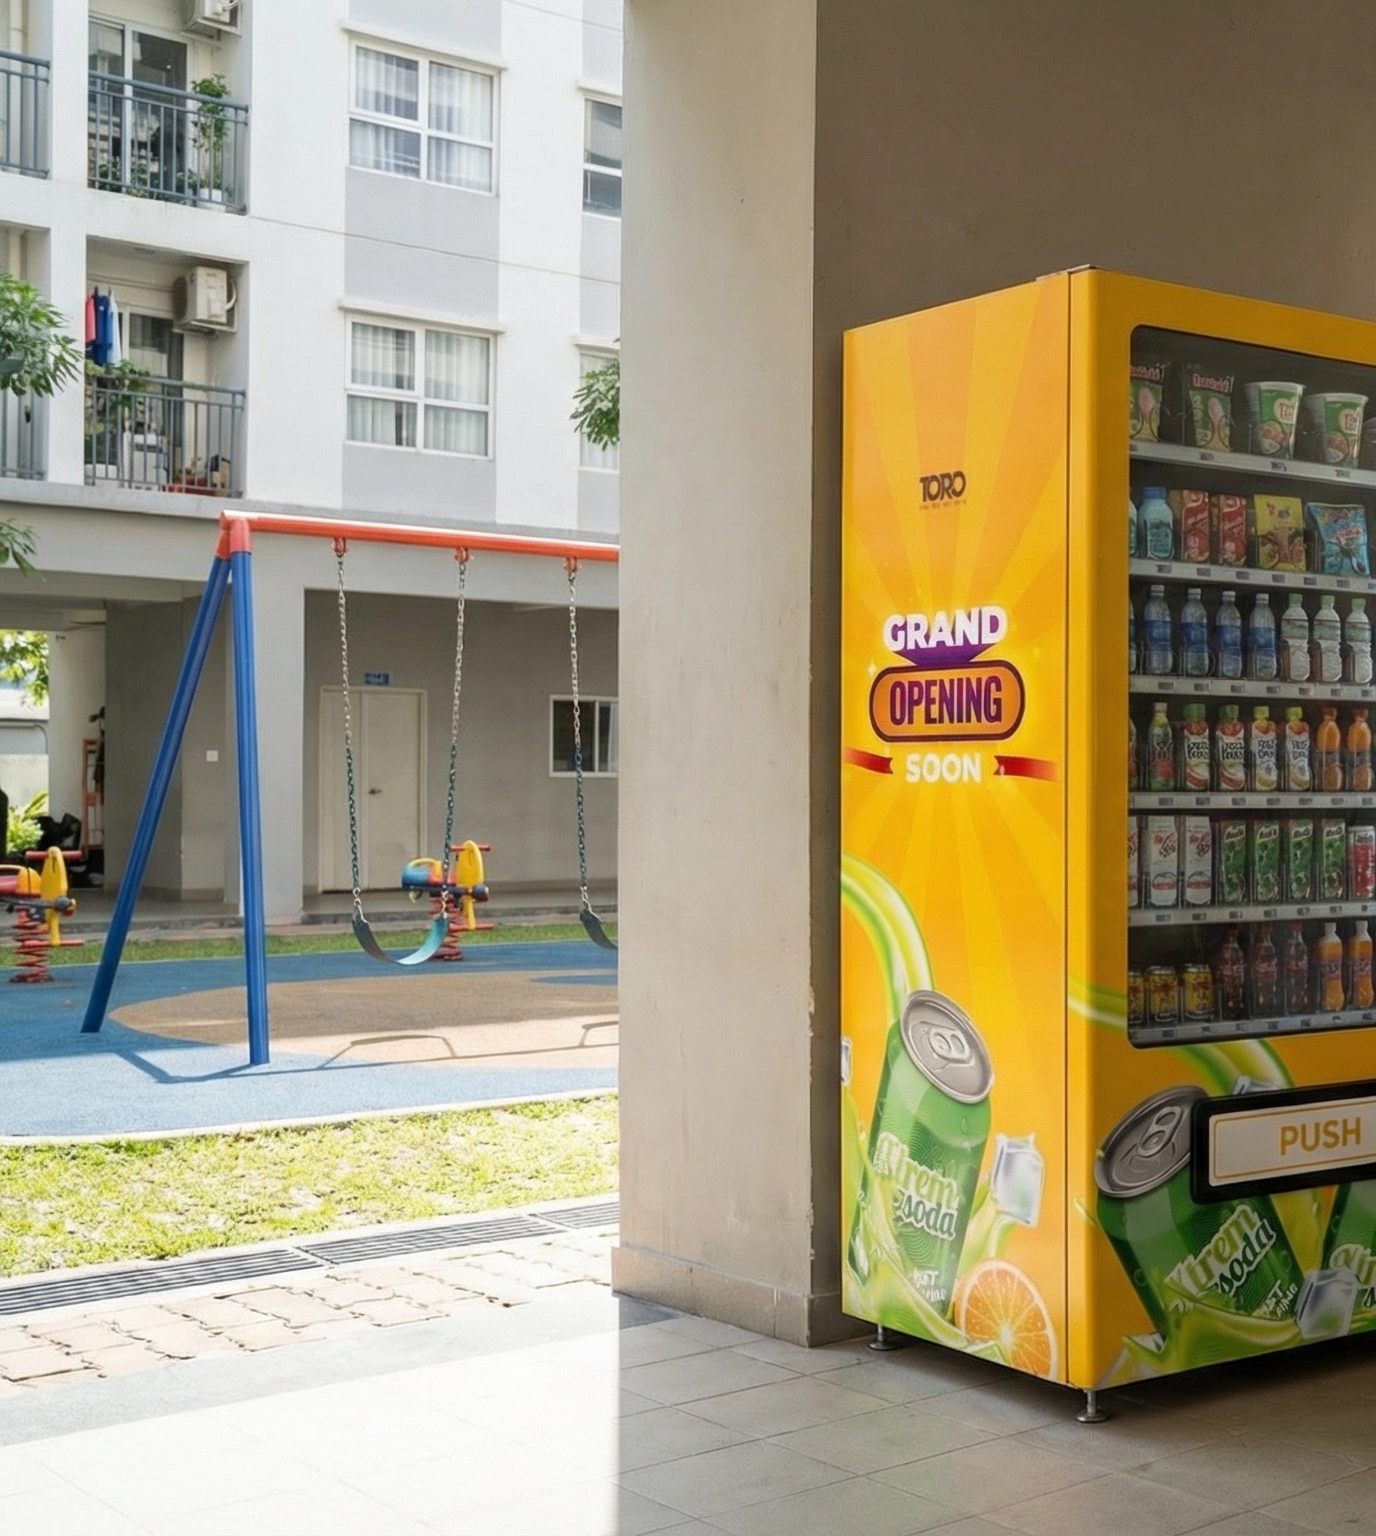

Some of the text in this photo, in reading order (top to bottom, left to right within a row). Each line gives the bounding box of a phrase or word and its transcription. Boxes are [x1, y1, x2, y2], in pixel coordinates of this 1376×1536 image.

[919, 470, 967, 502] TORO
[884, 605, 1007, 651] GRAND
[889, 676, 1003, 726] OPENING
[905, 753, 982, 783] SOON
[1279, 1116, 1362, 1155] PUSH
[901, 1193, 956, 1239] soda
[1215, 1220, 1275, 1298] soda
